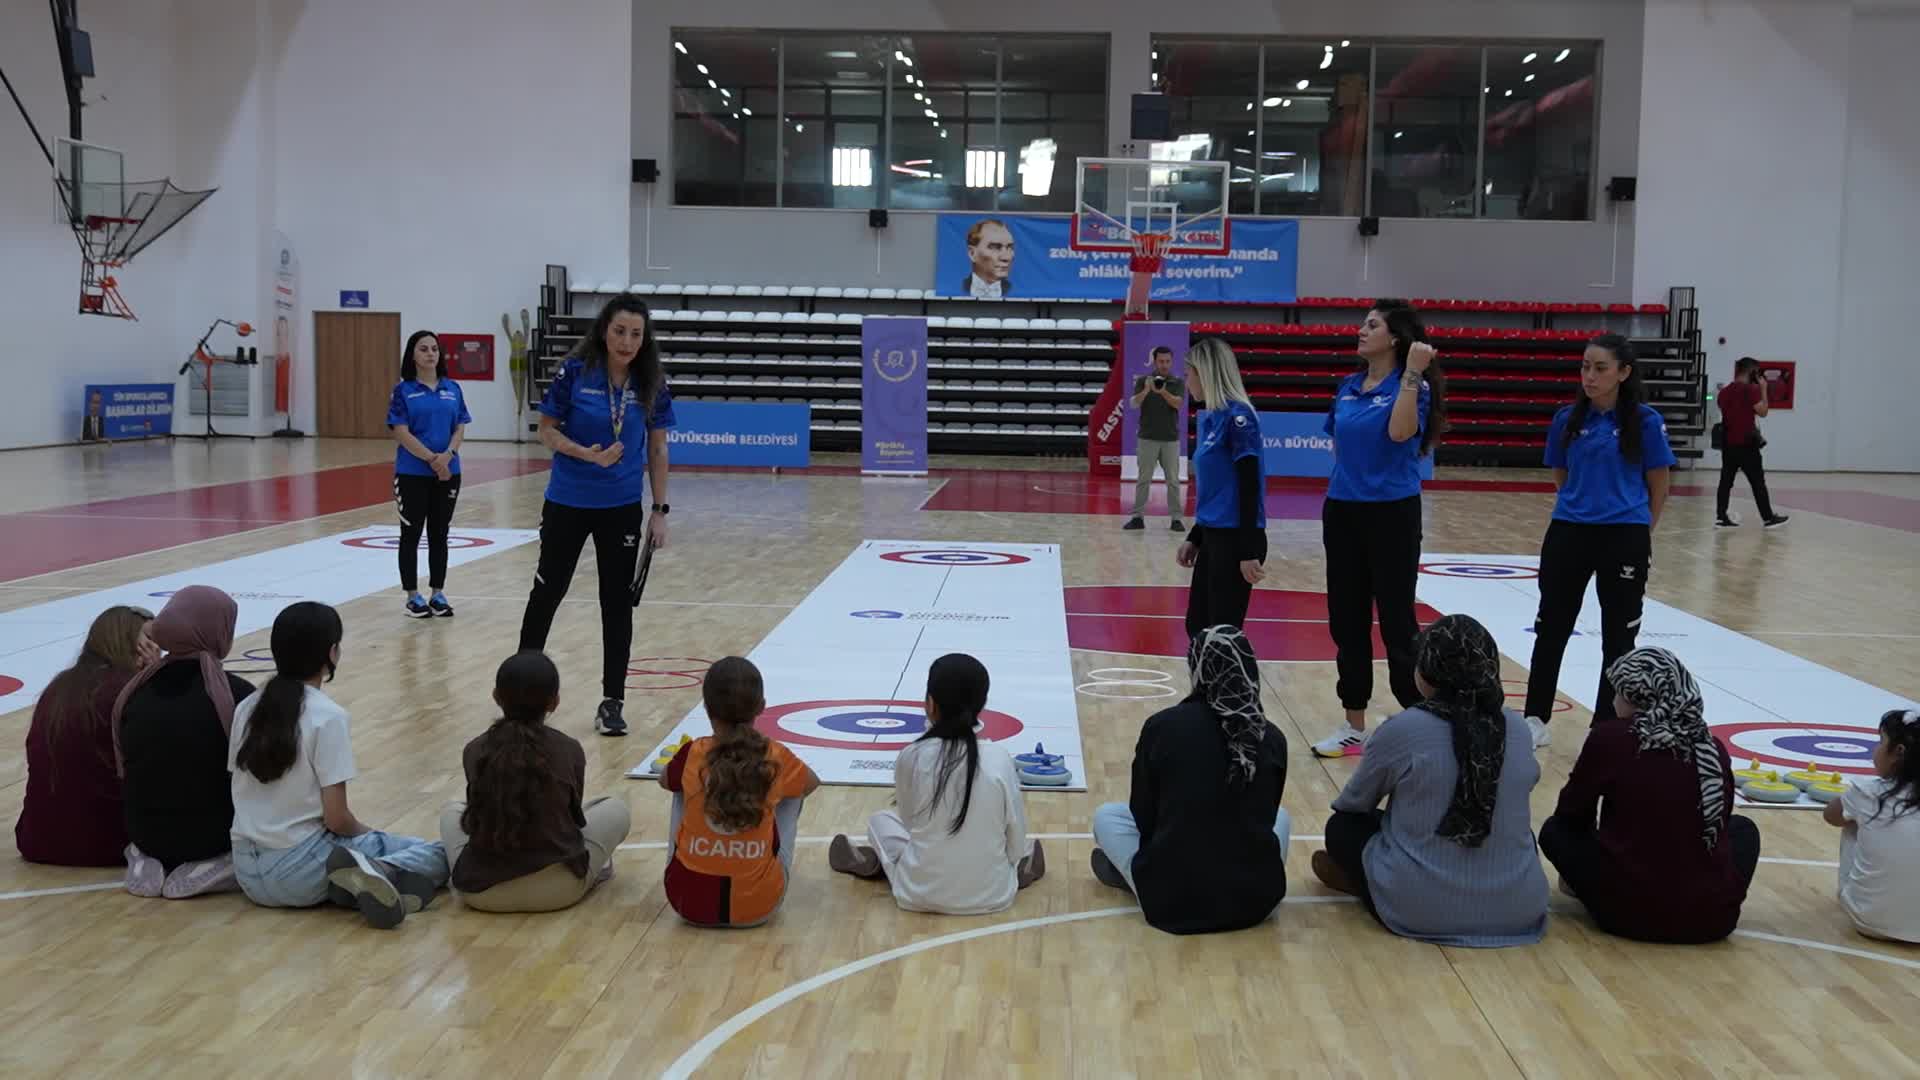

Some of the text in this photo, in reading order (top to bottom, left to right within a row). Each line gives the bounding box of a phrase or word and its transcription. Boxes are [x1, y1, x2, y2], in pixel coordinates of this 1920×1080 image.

[740, 433, 798, 446] BELEDİYESİ
[1284, 435, 1334, 451] BÜYÜKŞ
[689, 835, 767, 858] ICARDI
